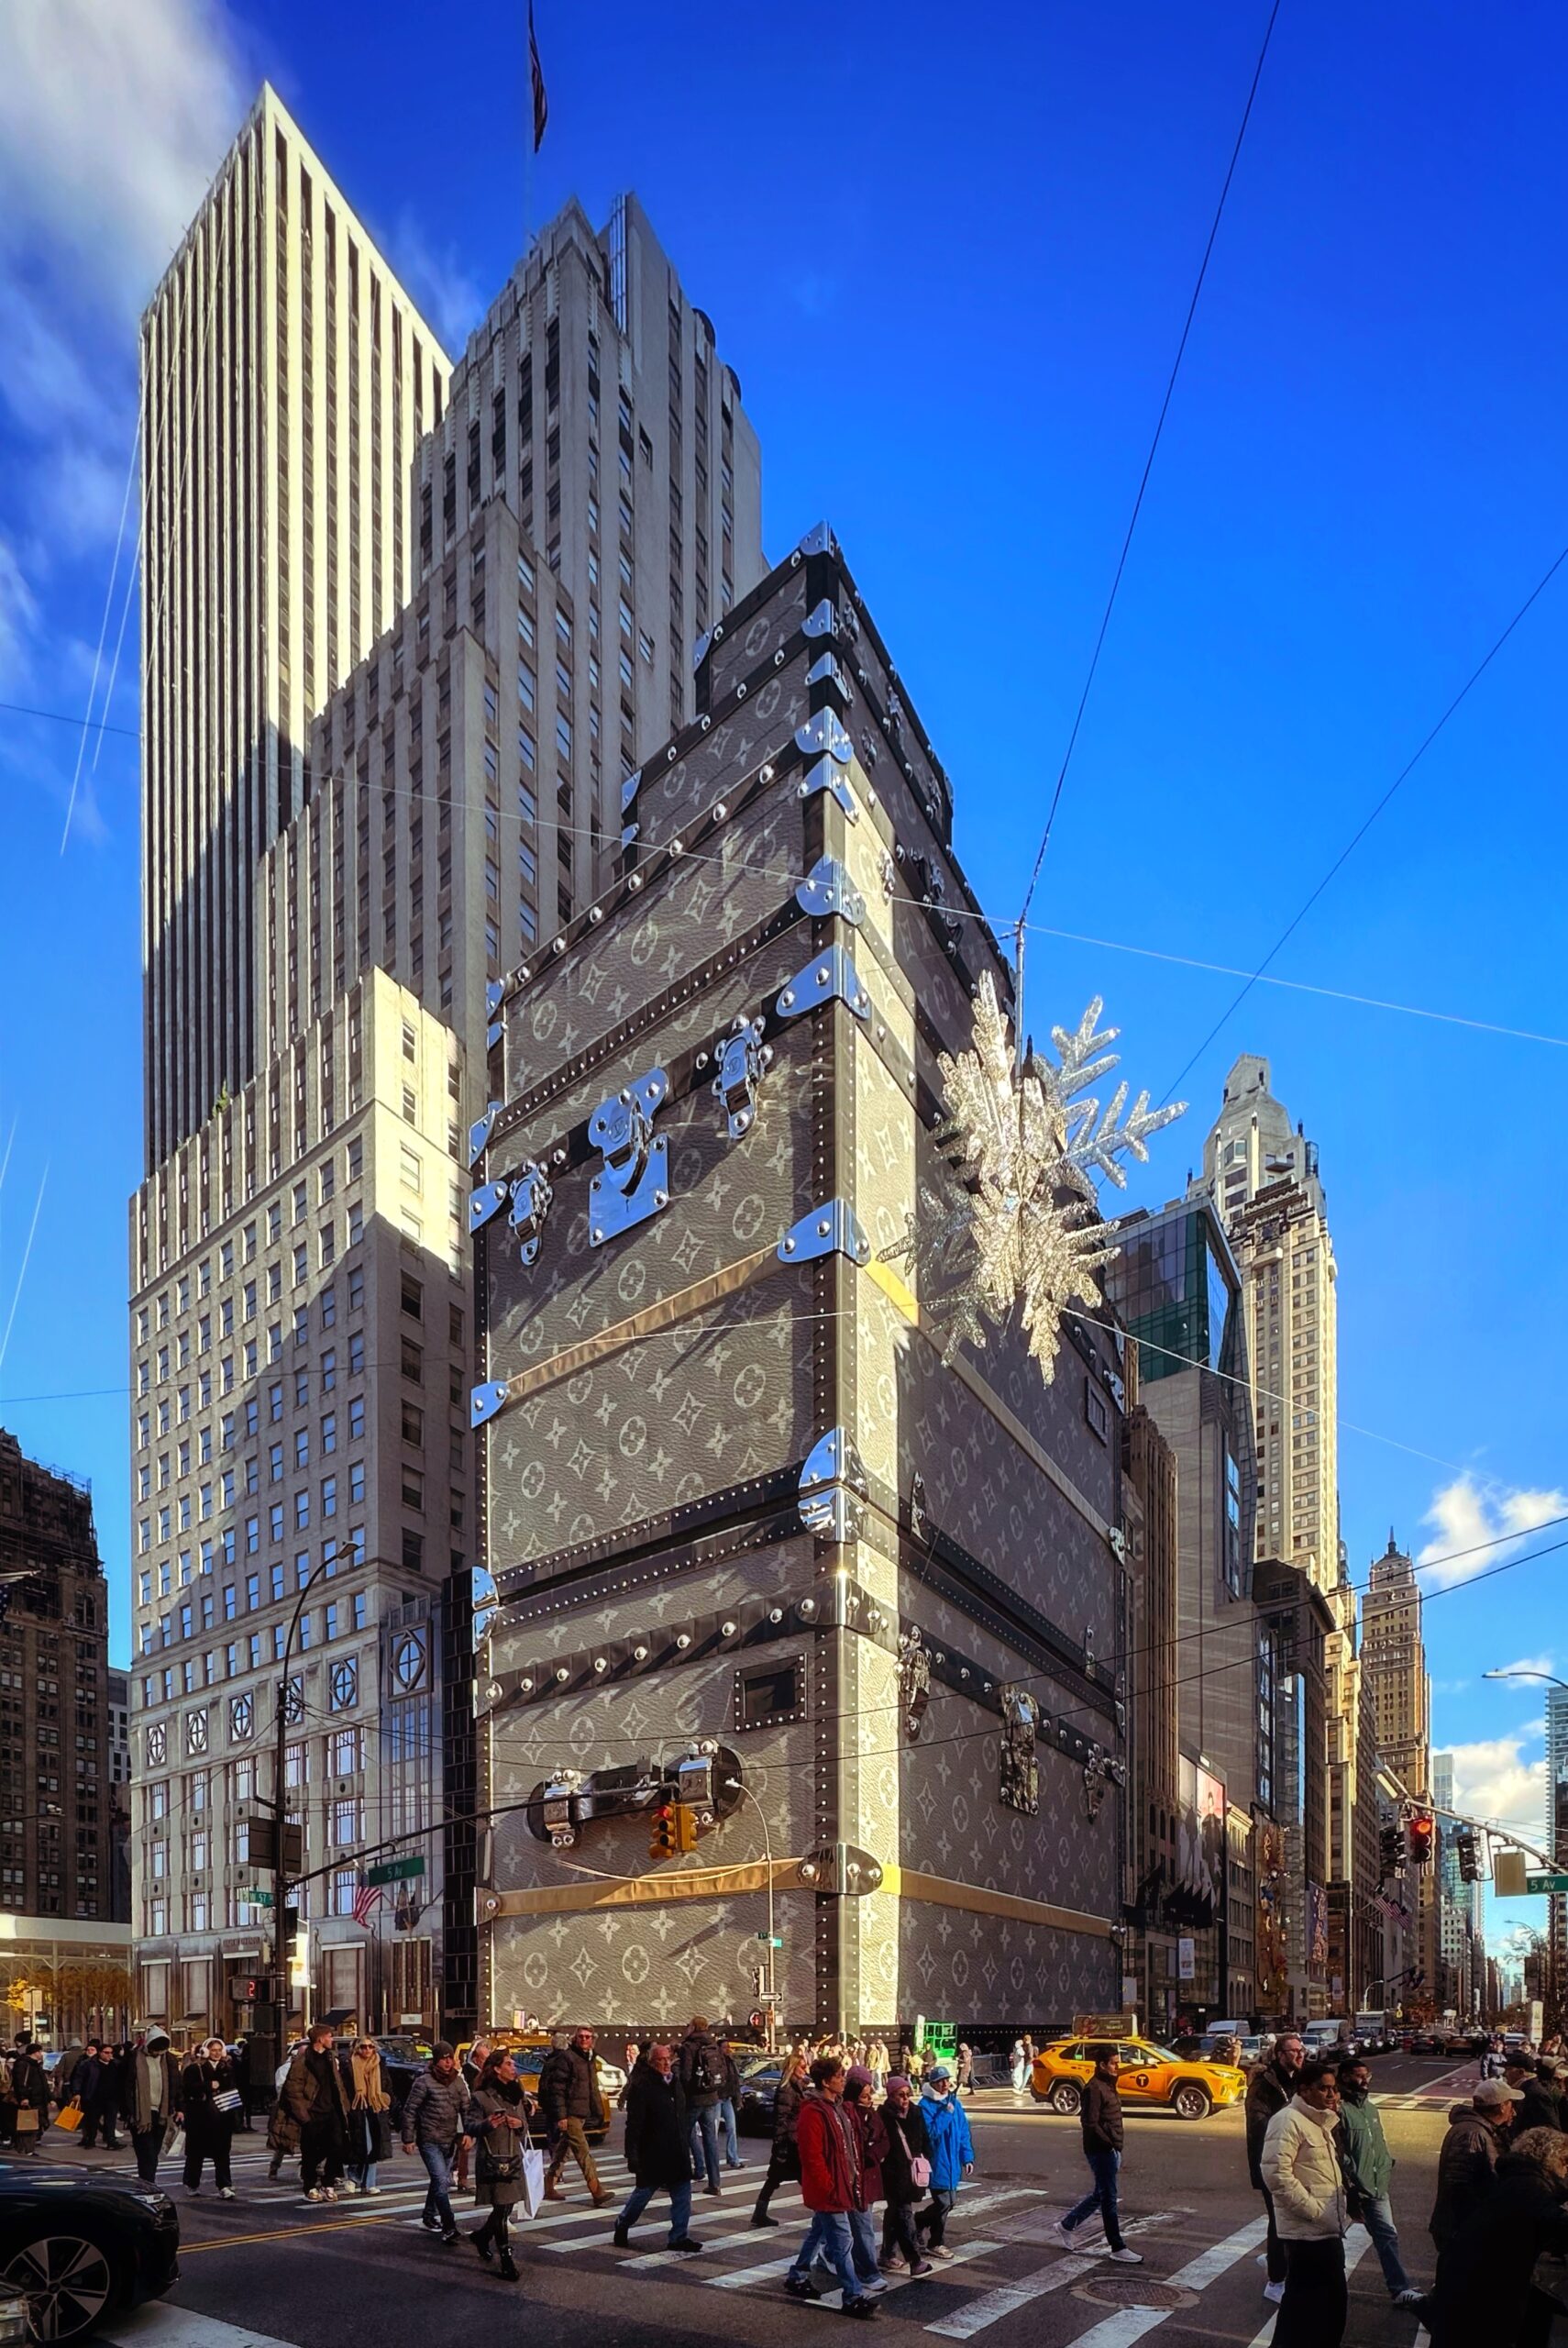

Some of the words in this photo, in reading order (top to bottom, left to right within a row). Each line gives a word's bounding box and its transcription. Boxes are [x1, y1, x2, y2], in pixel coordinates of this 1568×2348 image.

[388, 1866, 392, 1879] 5
[1530, 1879, 1538, 1890] 5
[258, 1893, 267, 1903] 57
[248, 1981, 255, 1997] 2
[1138, 2076, 1146, 2086] T
